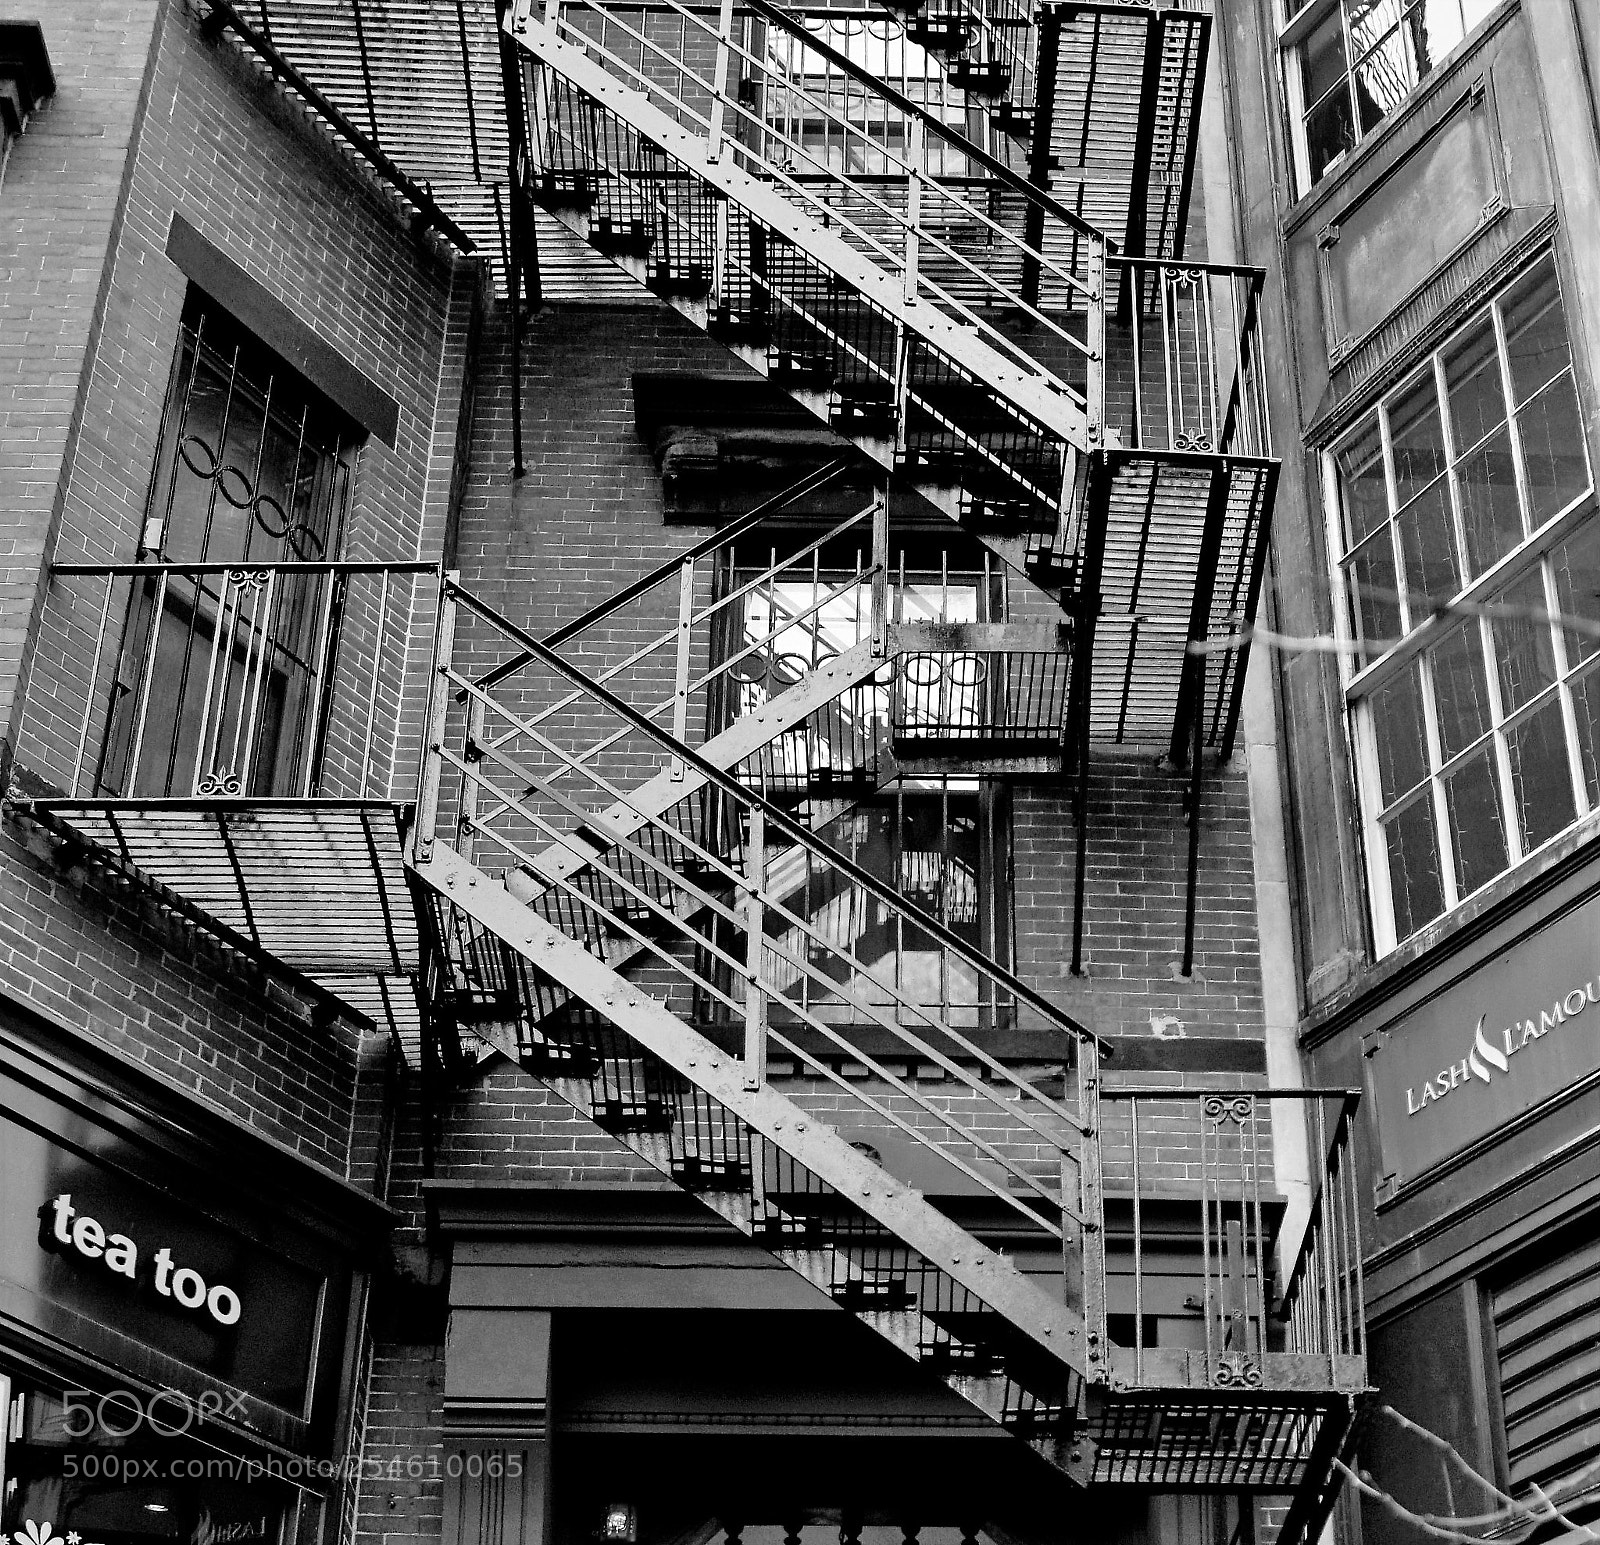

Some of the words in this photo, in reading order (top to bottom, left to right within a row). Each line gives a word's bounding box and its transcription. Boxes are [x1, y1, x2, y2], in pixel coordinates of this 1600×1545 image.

[1405, 1058, 1471, 1116] LASH
[52, 1193, 137, 1280] tea
[153, 1247, 242, 1326] too
